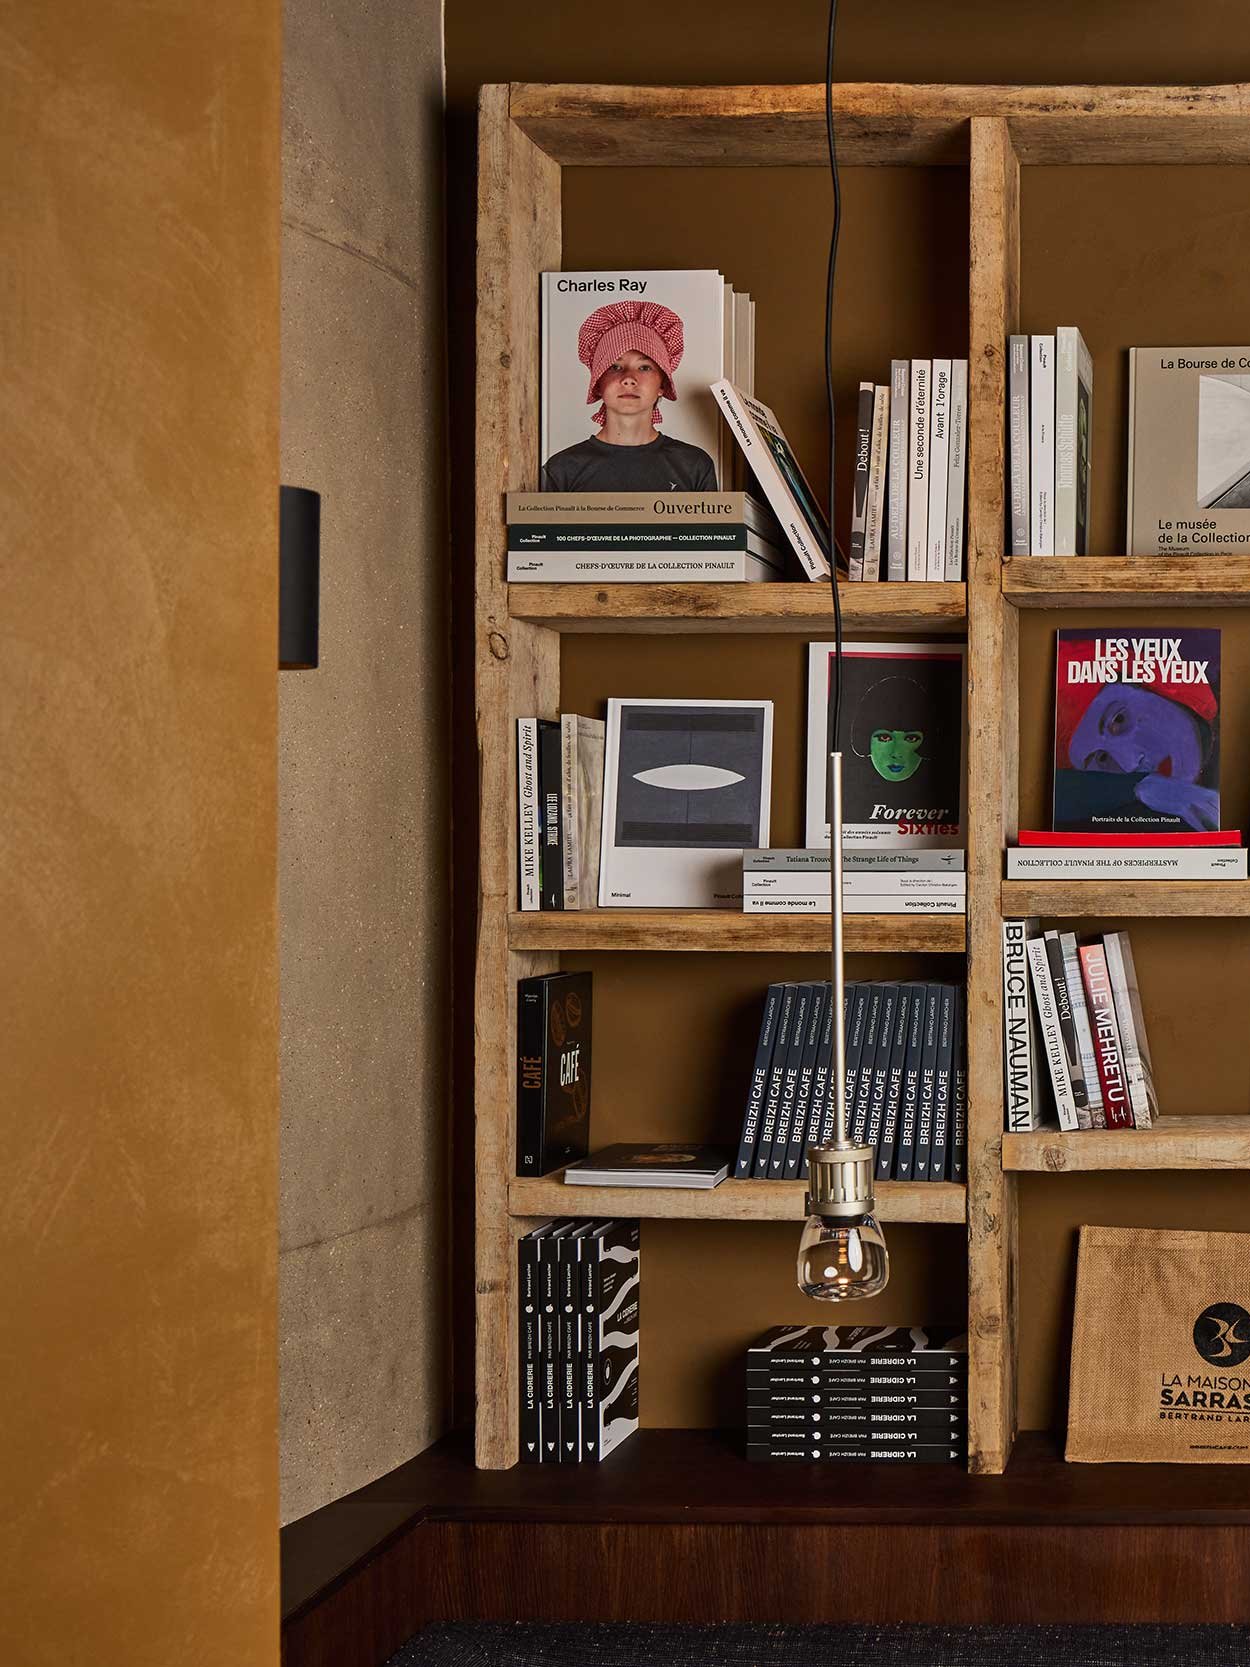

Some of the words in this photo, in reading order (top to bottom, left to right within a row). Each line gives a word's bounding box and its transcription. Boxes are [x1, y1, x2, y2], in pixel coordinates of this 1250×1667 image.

[557, 280, 615, 292] Charles
[620, 279, 647, 294] Ray
[1161, 358, 1174, 368] La
[1178, 358, 1218, 368] Bourse
[1221, 358, 1236, 368] de
[916, 369, 926, 414] d'éternité
[936, 372, 948, 407] l'orage
[915, 417, 925, 458] seconde
[936, 412, 944, 440] Avant
[856, 428, 870, 472] Debout!
[914, 460, 924, 480] Une
[653, 500, 732, 515] Ouverture
[1158, 520, 1167, 530] Le
[1176, 518, 1216, 530] musée
[629, 534, 671, 542] PHOTOGRAPHIE
[678, 534, 712, 542] COLLECTION
[1158, 534, 1174, 544] de
[1177, 534, 1188, 544] la
[576, 562, 634, 570] CHEFS-D'ŒUVRE
[636, 562, 646, 570] DE
[648, 562, 657, 570] LA
[658, 562, 704, 570] COLLECTION
[705, 562, 735, 570] PINAULT
[1095, 638, 1129, 661] LES
[1131, 638, 1182, 661] YEUX
[1068, 661, 1118, 684] DANS
[1122, 661, 1156, 684] LES
[1158, 661, 1209, 684] YEUX
[522, 725, 534, 752] Spirit
[524, 752, 532, 772] and
[524, 772, 532, 798] Ghost
[524, 804, 533, 846] KELLEY
[870, 804, 948, 820] Forever
[1092, 816, 1115, 824] Portraits
[1116, 816, 1123, 824] de
[1124, 816, 1130, 824] la
[1130, 816, 1160, 824] Collection
[1161, 816, 1180, 824] Pinault
[897, 818, 960, 836] Sixties
[525, 849, 534, 877] MIKE
[852, 856, 876, 864] Strange
[898, 856, 919, 864] Things
[1005, 926, 1026, 1008] BRUCE
[1086, 954, 1108, 1004] JULIE
[1054, 976, 1071, 1020] Debout!
[560, 1044, 580, 1086] CAFÉ
[1094, 1009, 1124, 1102] MEHRETU
[520, 1056, 542, 1088] CAFÉ
[1008, 1018, 1030, 1128] NAUMAN
[938, 1070, 947, 1101] CAFE
[744, 1101, 759, 1144] BREIZH
[752, 1069, 765, 1099] CAFE
[792, 1100, 806, 1143] BREIZH
[800, 1068, 812, 1098] CAFE
[936, 1103, 945, 1146] BREIZH
[1162, 1373, 1182, 1387] LA
[528, 1400, 533, 1409] LA
[588, 1400, 594, 1409] LA
[1160, 1412, 1222, 1422] BERTRAND
